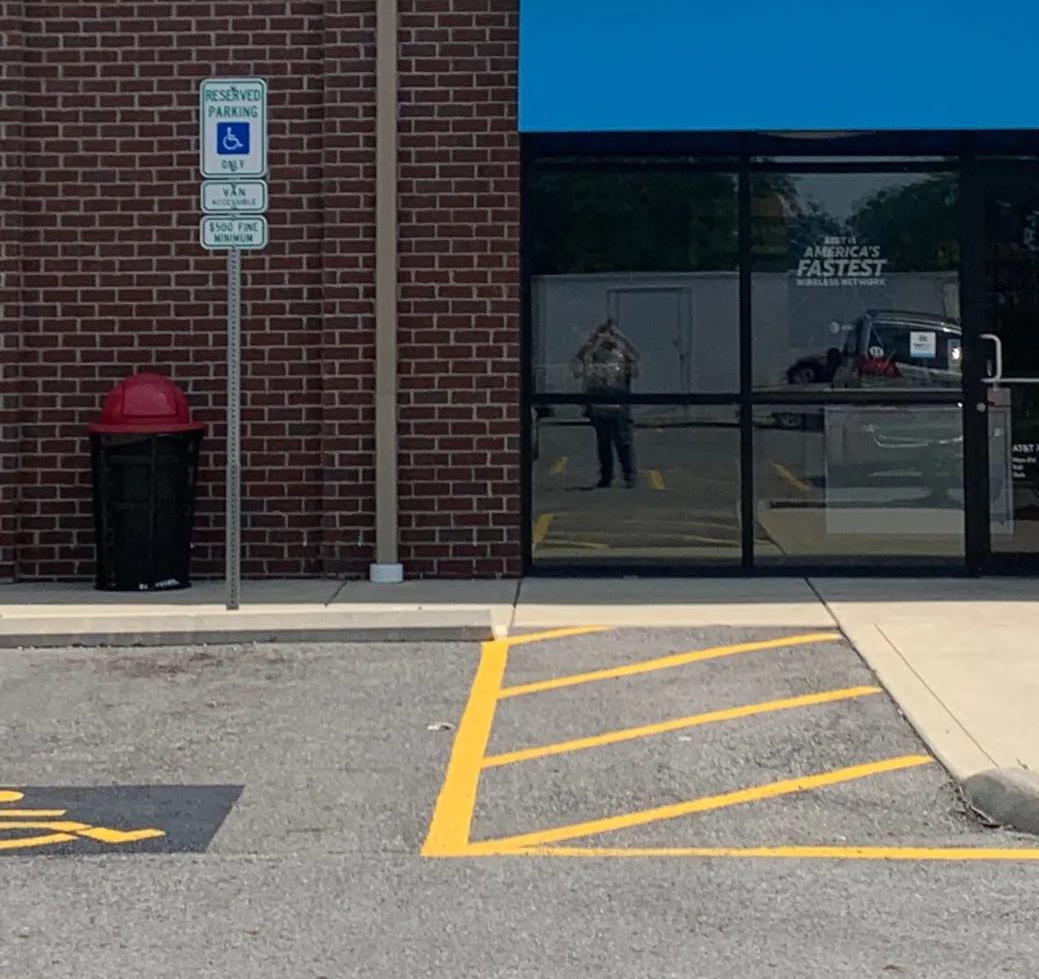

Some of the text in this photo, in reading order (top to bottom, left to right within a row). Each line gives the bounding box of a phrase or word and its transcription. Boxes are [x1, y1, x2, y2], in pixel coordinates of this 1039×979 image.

[205, 89, 261, 101] RESERVED
[208, 106, 258, 118] PARKING
[221, 160, 245, 170] ONLY
[222, 187, 246, 197] VAN
[209, 223, 258, 233] $500 FINE
[214, 234, 253, 243] MINIMUM
[803, 245, 881, 258] AMERICA'S
[796, 258, 888, 277] FASTEST
[796, 278, 887, 287] WIRELESS NETWORK
